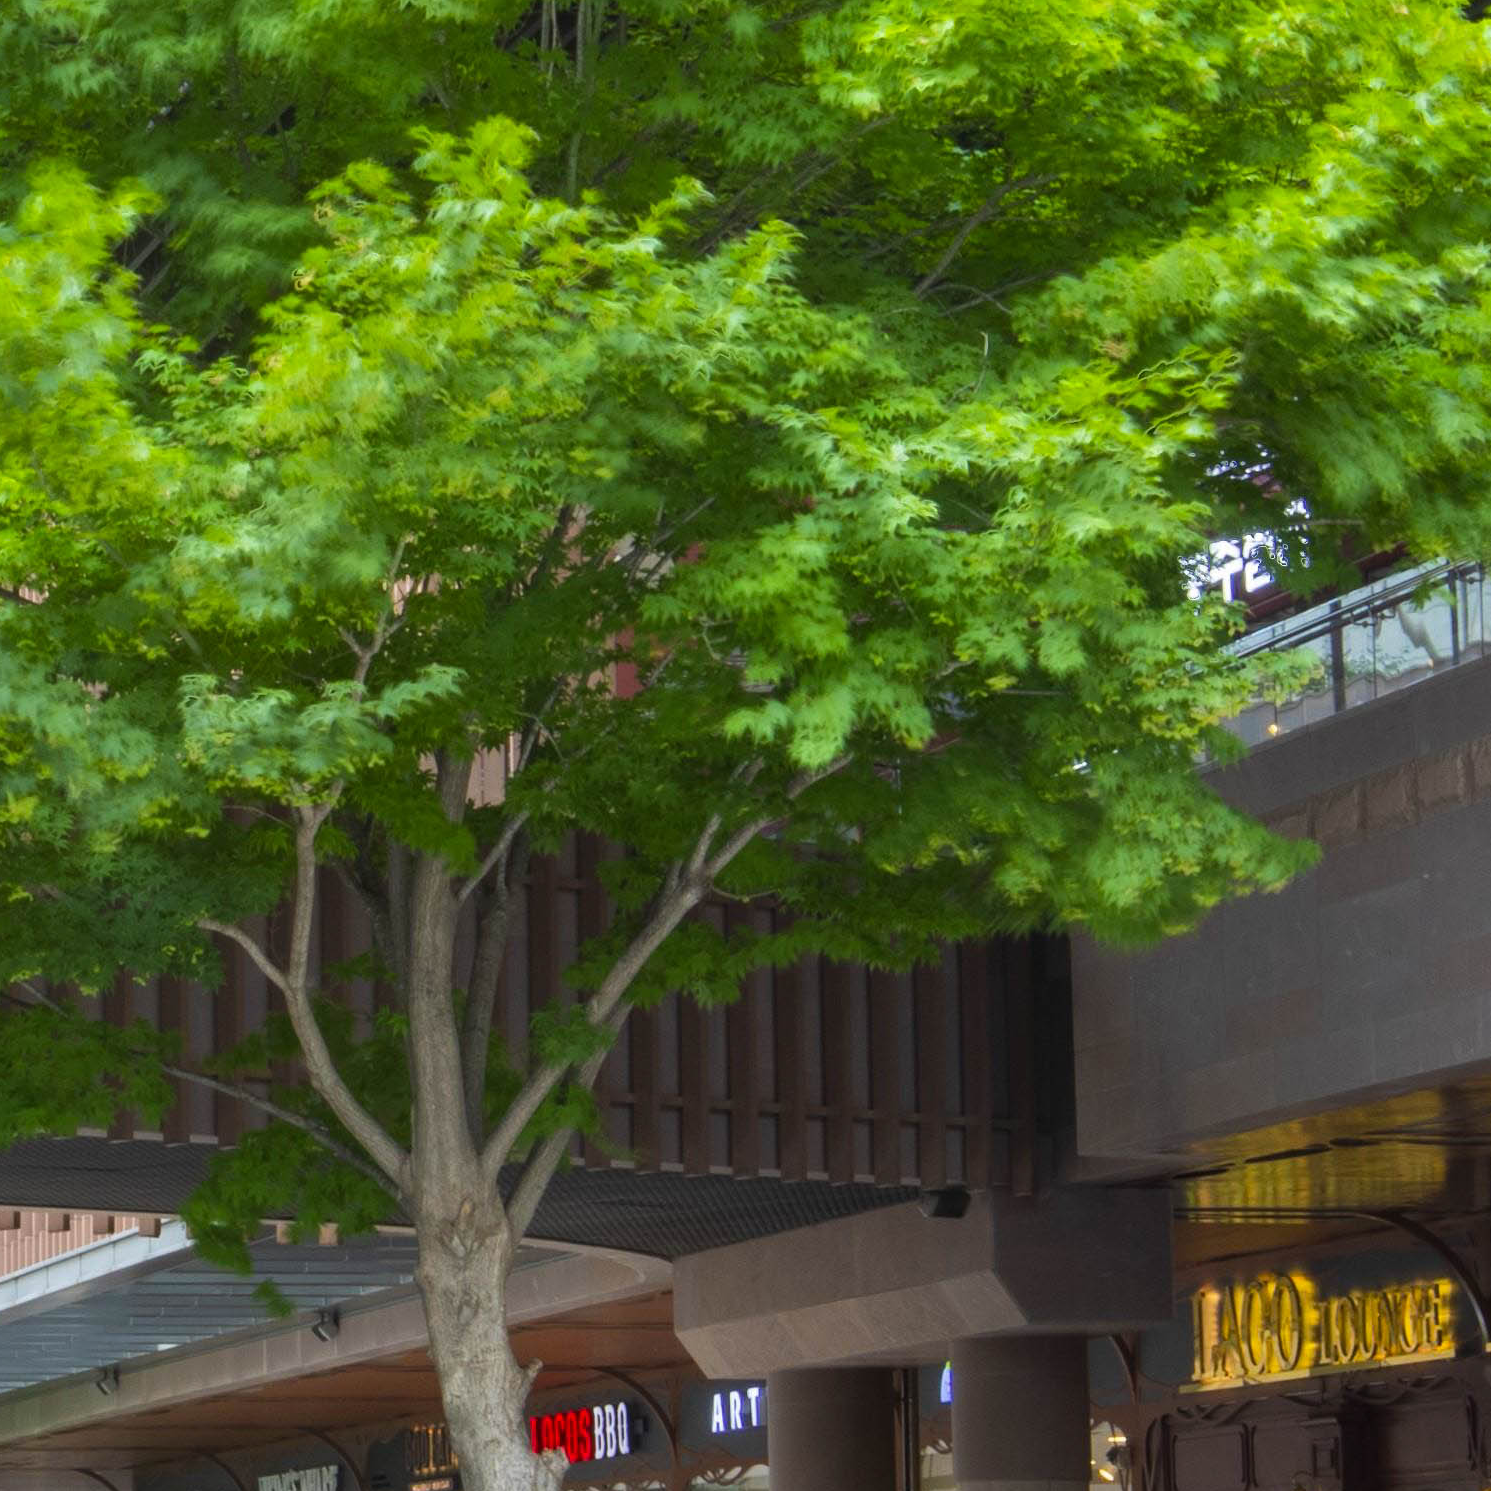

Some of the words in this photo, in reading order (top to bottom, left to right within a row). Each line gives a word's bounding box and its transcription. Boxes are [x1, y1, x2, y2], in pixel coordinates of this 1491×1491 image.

[1191, 1275, 1301, 1381] LAGO
[1318, 1283, 1443, 1365] LOUNGE
[593, 1402, 630, 1460] BBQ
